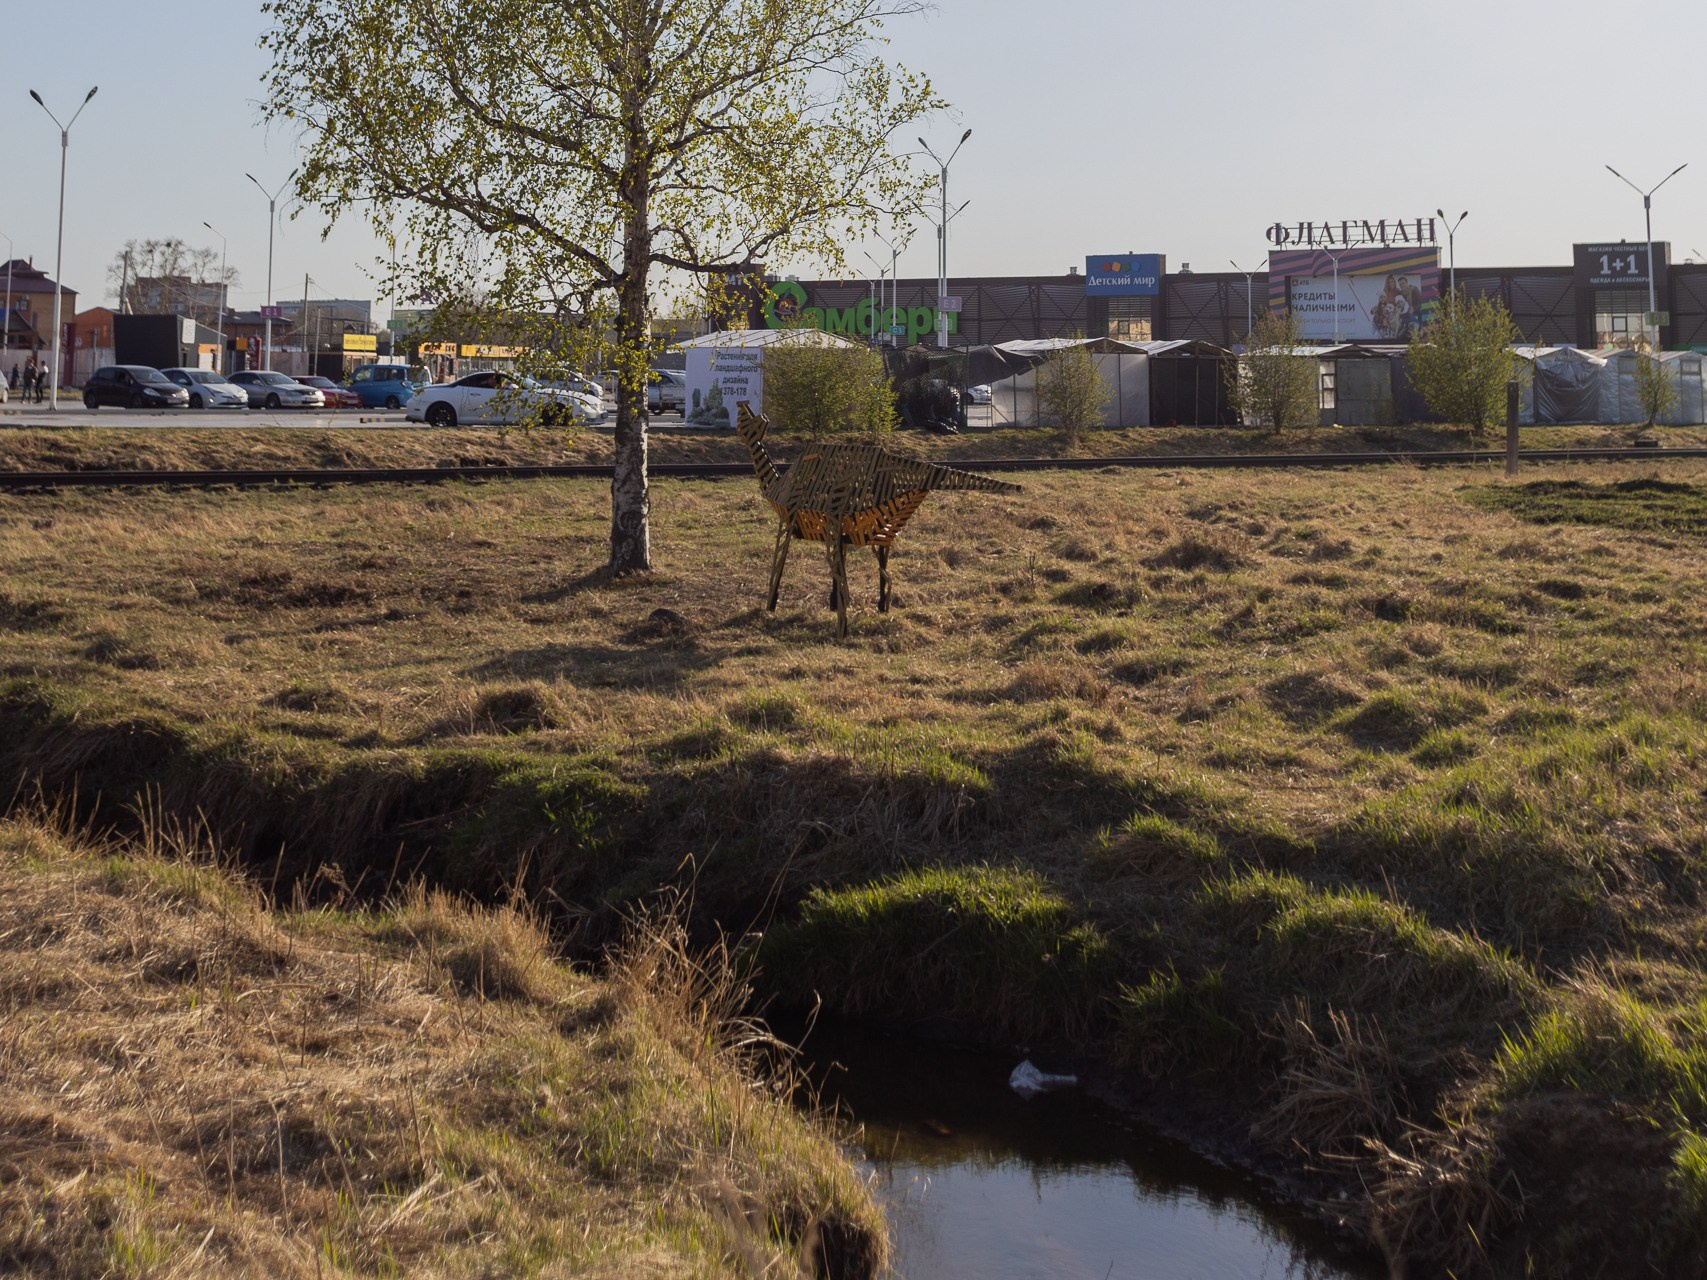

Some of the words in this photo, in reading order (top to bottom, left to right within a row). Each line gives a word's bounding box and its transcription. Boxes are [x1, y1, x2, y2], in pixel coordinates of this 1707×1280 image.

[1266, 218, 1436, 245] ФЛАГМАН
[1600, 255, 1638, 274] 1+1
[1088, 275, 1130, 286] Детский
[1133, 276, 1155, 287] мир
[1291, 292, 1336, 302] КРЕДИТЫ
[1292, 303, 1356, 313] НАЛИЧНЫМИ
[722, 375, 749, 385] дизайна
[723, 387, 747, 396] 378-178
